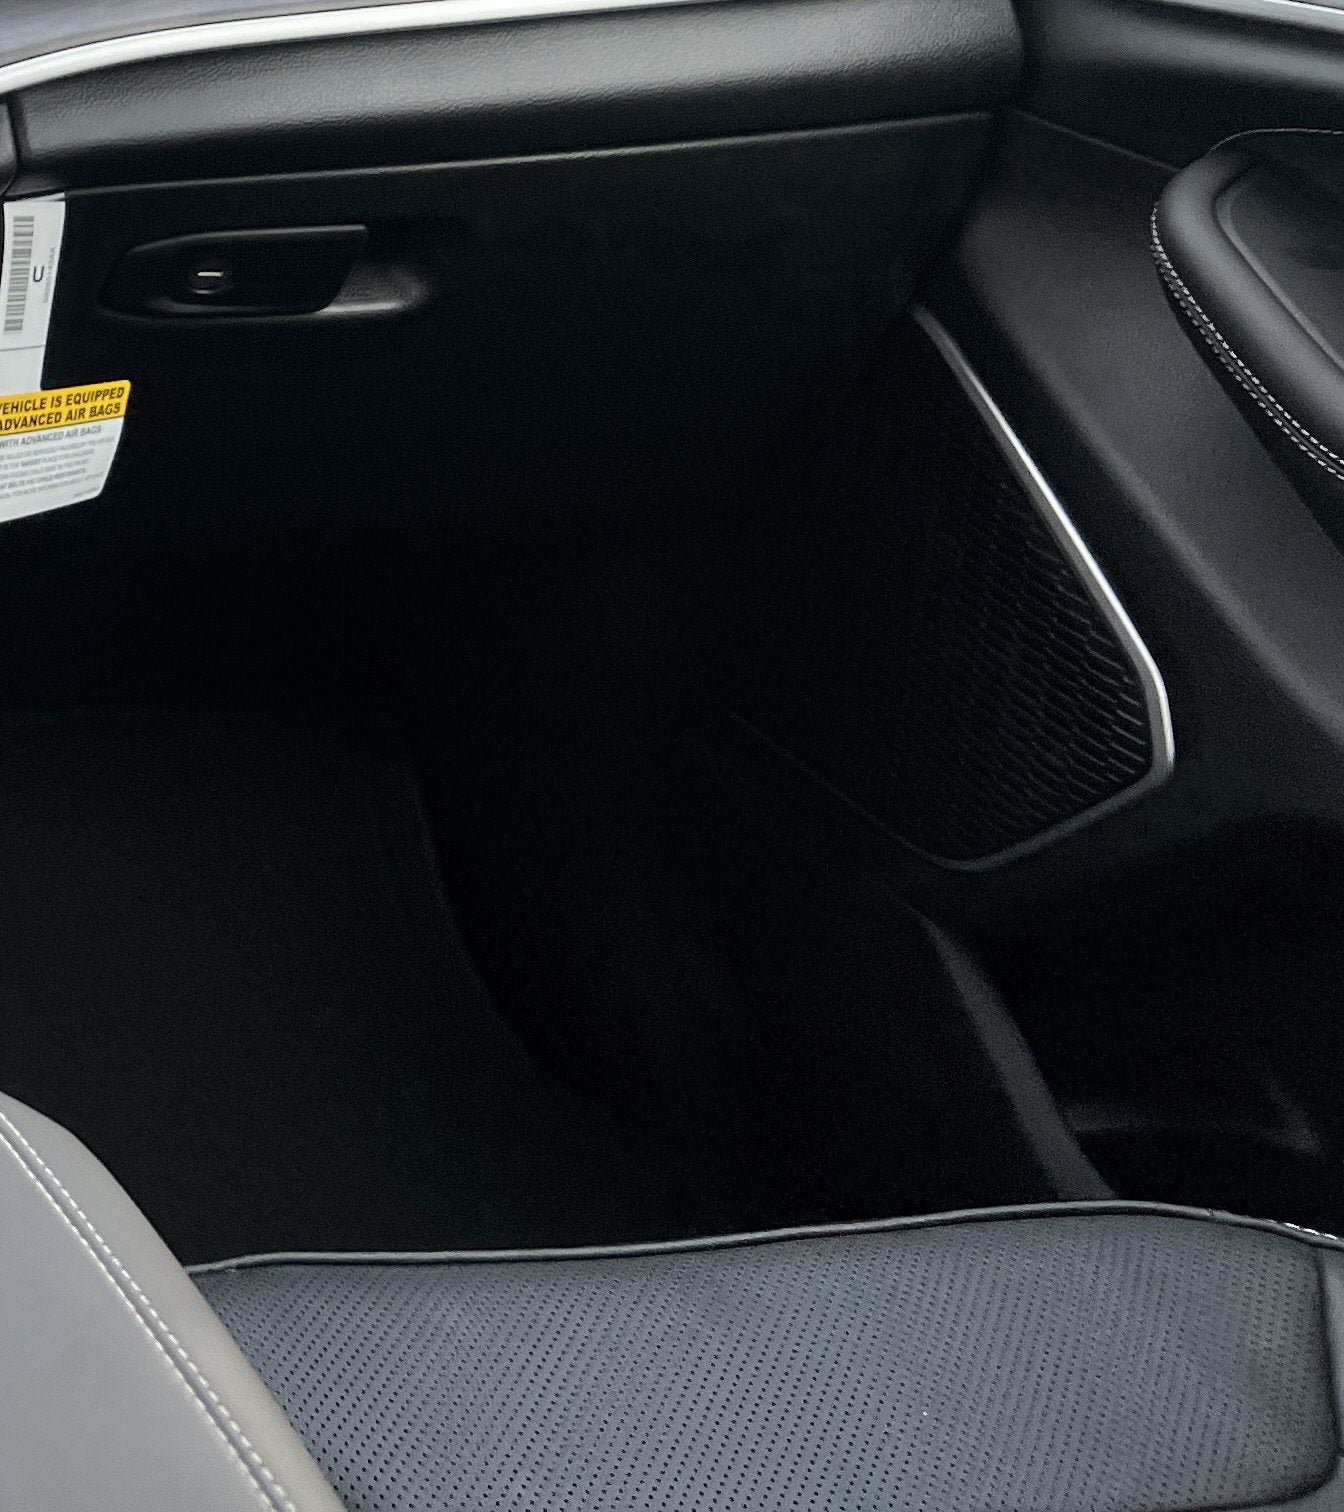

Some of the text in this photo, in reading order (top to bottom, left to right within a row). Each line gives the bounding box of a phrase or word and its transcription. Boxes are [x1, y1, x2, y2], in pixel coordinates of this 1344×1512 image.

[50, 396, 62, 408] IS
[66, 387, 125, 405] EQUIPPED
[65, 407, 85, 421] AIR
[89, 402, 121, 417] BAGS
[21, 431, 64, 445] ADVANCED
[65, 428, 78, 439] AIR
